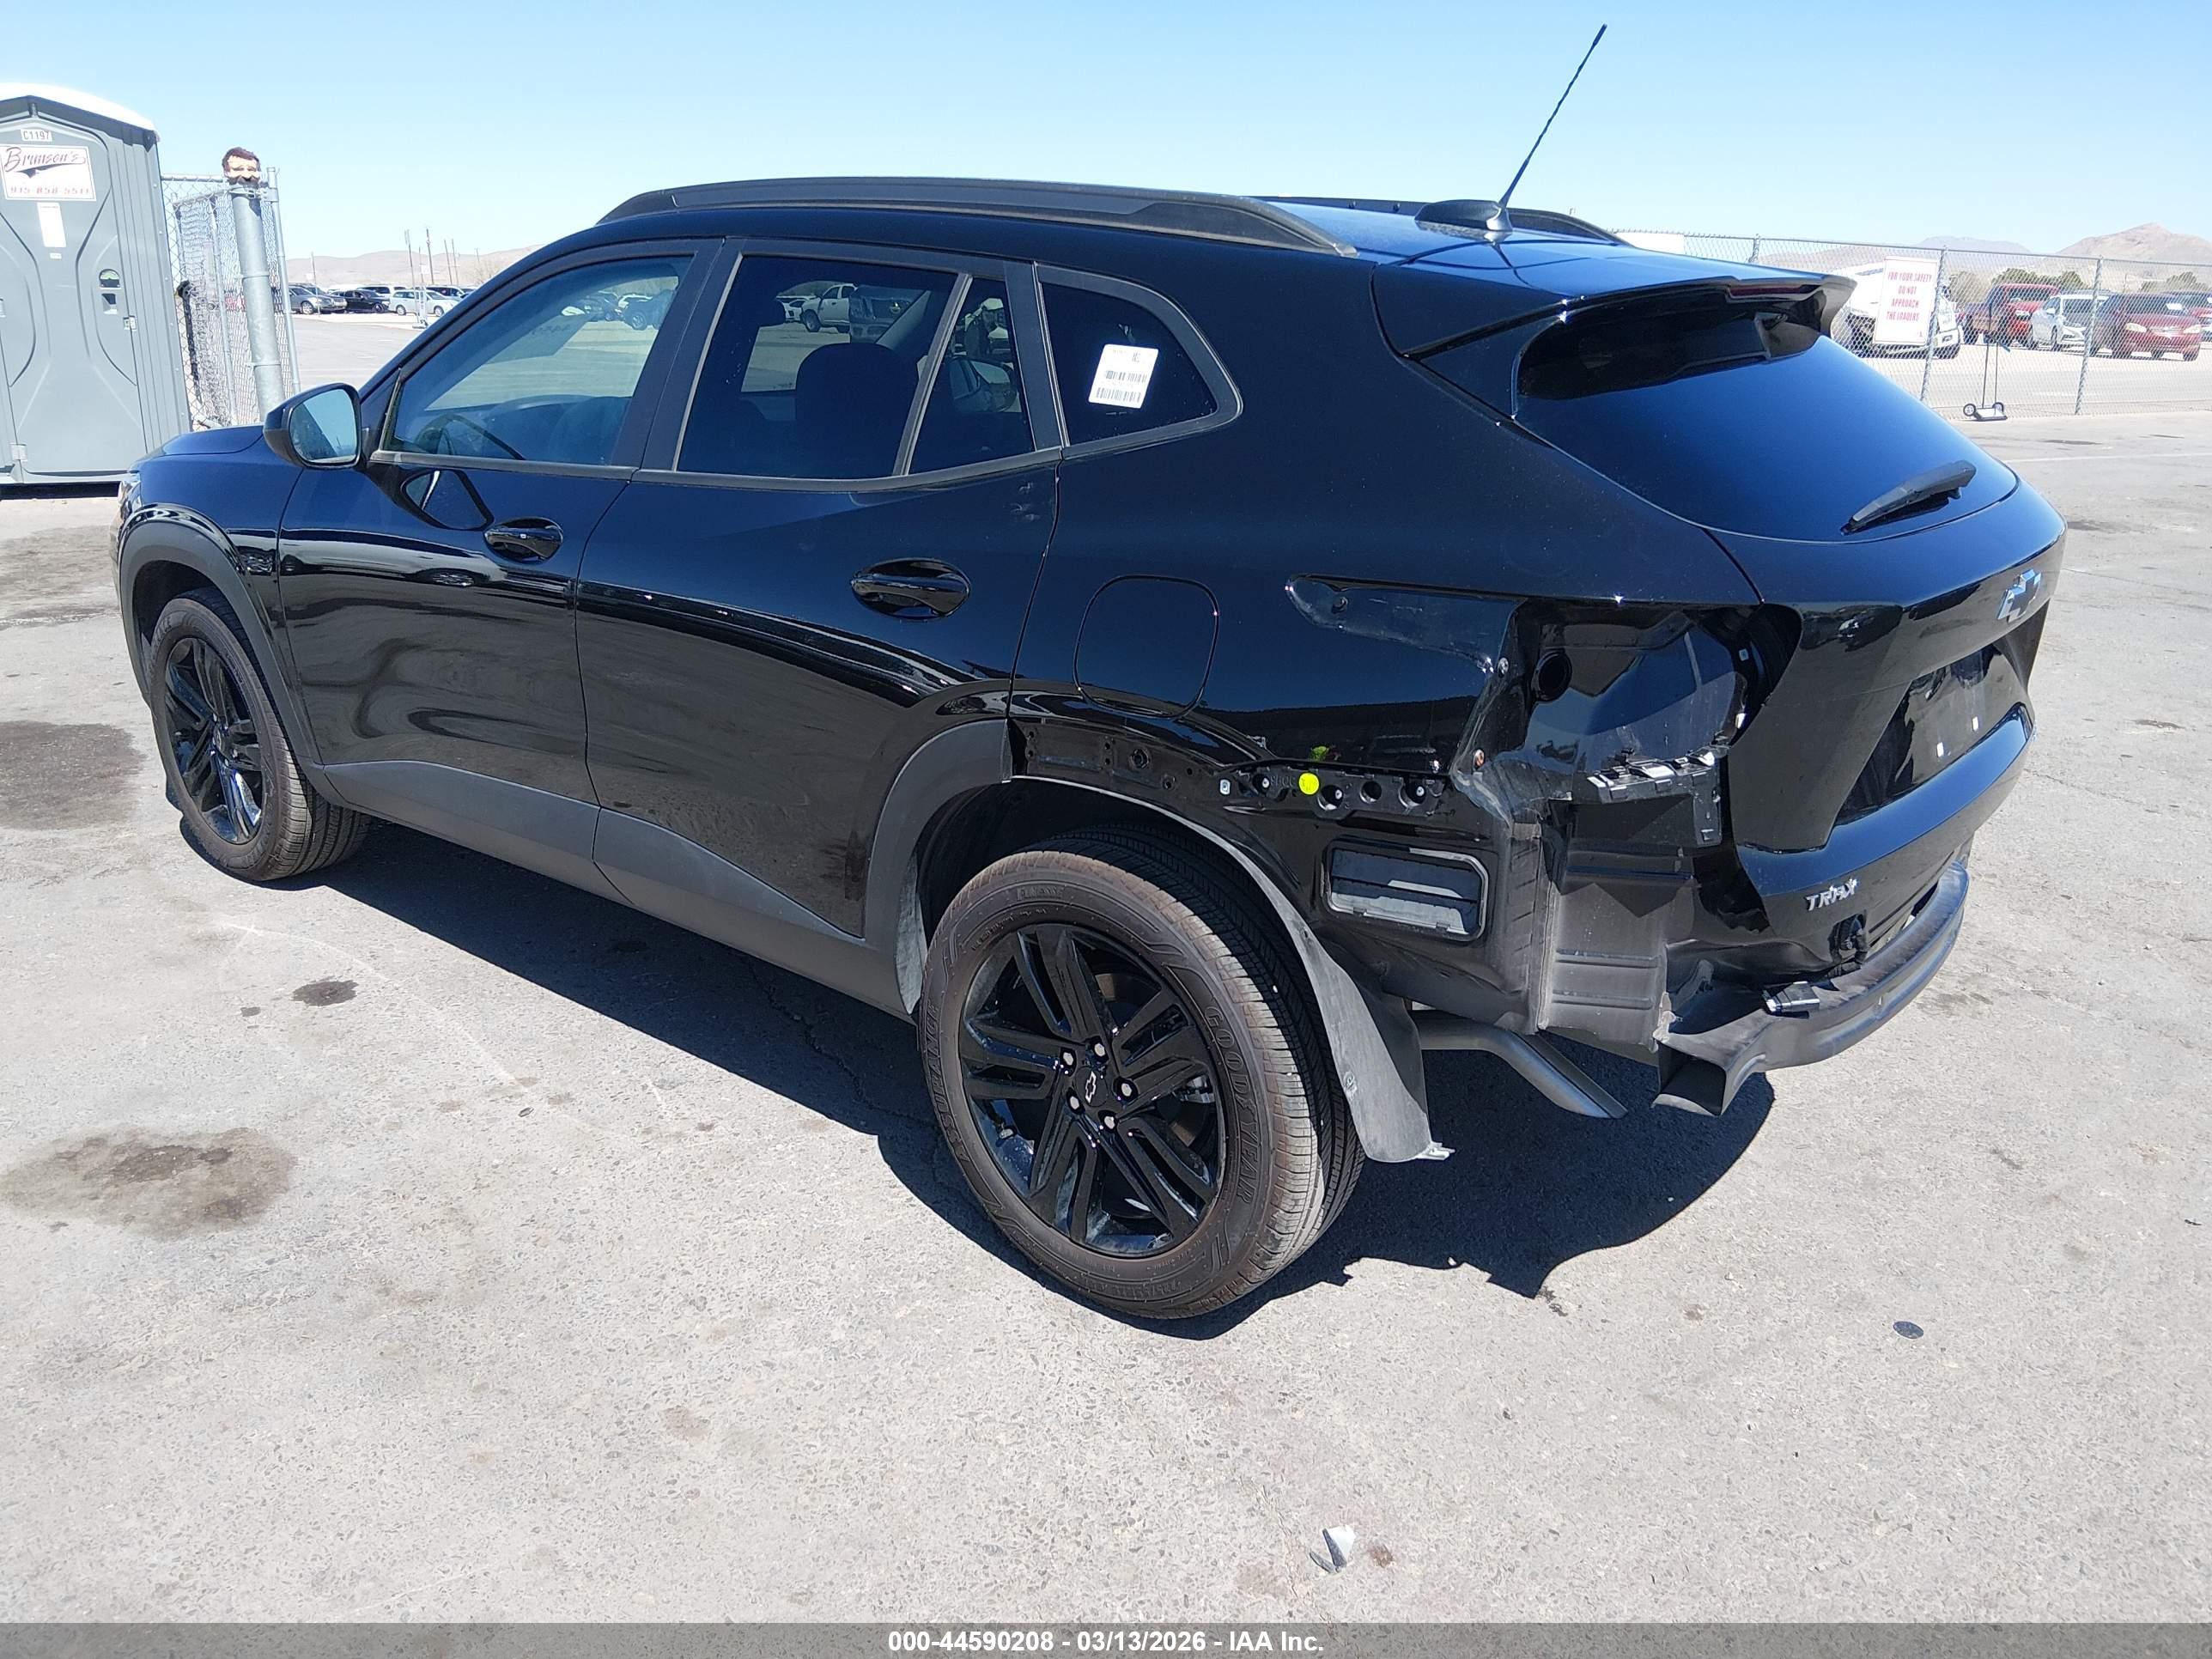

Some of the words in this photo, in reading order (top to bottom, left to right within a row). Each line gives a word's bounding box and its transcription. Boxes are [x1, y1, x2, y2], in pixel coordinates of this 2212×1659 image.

[22, 131, 50, 140] C1197
[1887, 271, 1899, 281] FOR
[1899, 272, 1913, 282] YOUR
[1914, 273, 1932, 283] SAFETY
[1898, 285, 1905, 295] DO
[1906, 285, 1917, 295] NOT
[1891, 298, 1919, 308] APPROACH
[1886, 311, 1896, 320] THE
[1897, 312, 1920, 321] LOADERS
[1806, 878, 1858, 911] TRAX
[927, 999, 971, 1164] ASSURANCE
[1205, 1005, 1257, 1204] GOODYEAR
